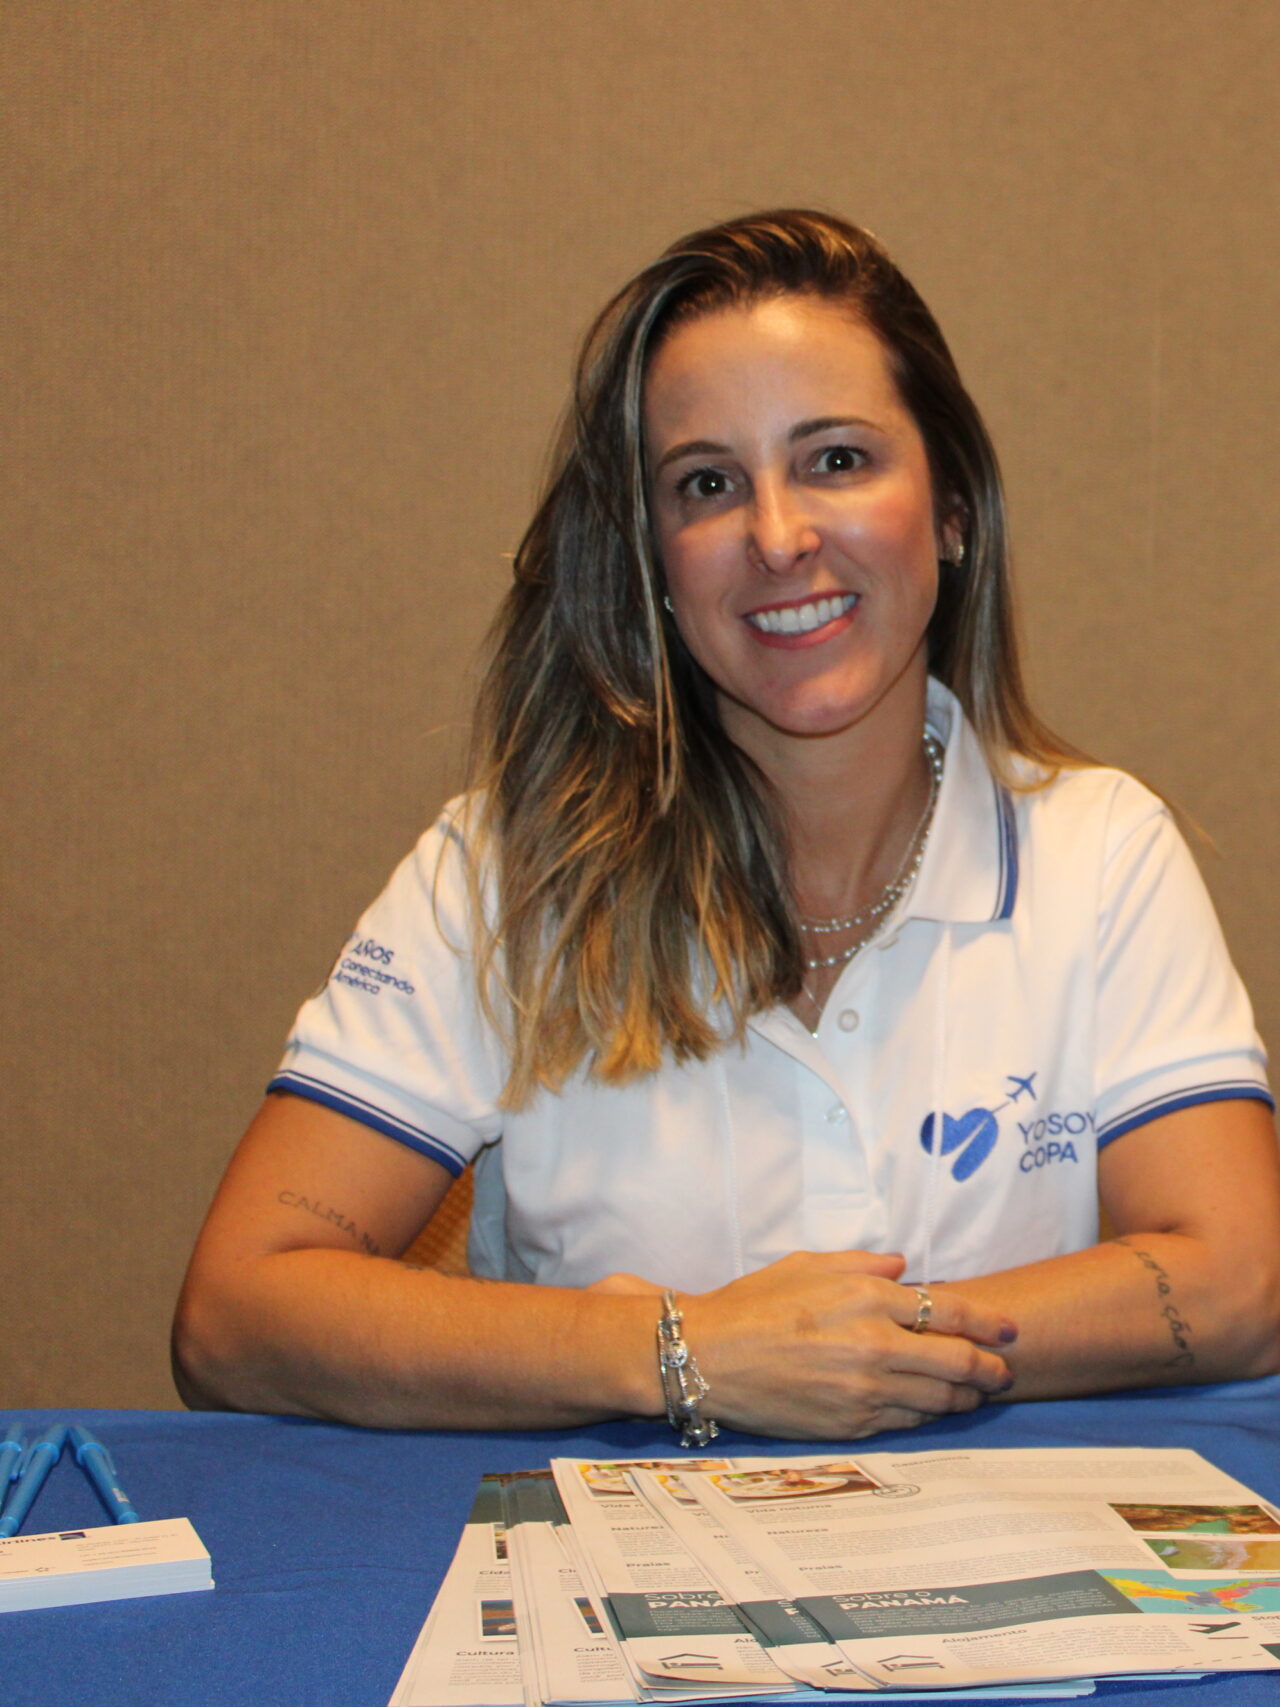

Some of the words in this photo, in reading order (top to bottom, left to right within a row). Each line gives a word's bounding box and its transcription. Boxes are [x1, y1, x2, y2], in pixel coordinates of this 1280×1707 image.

[1018, 1141, 1079, 1173] COPA
[832, 1592, 909, 1603] Sobre
[839, 1594, 970, 1610] PANAMÁ
